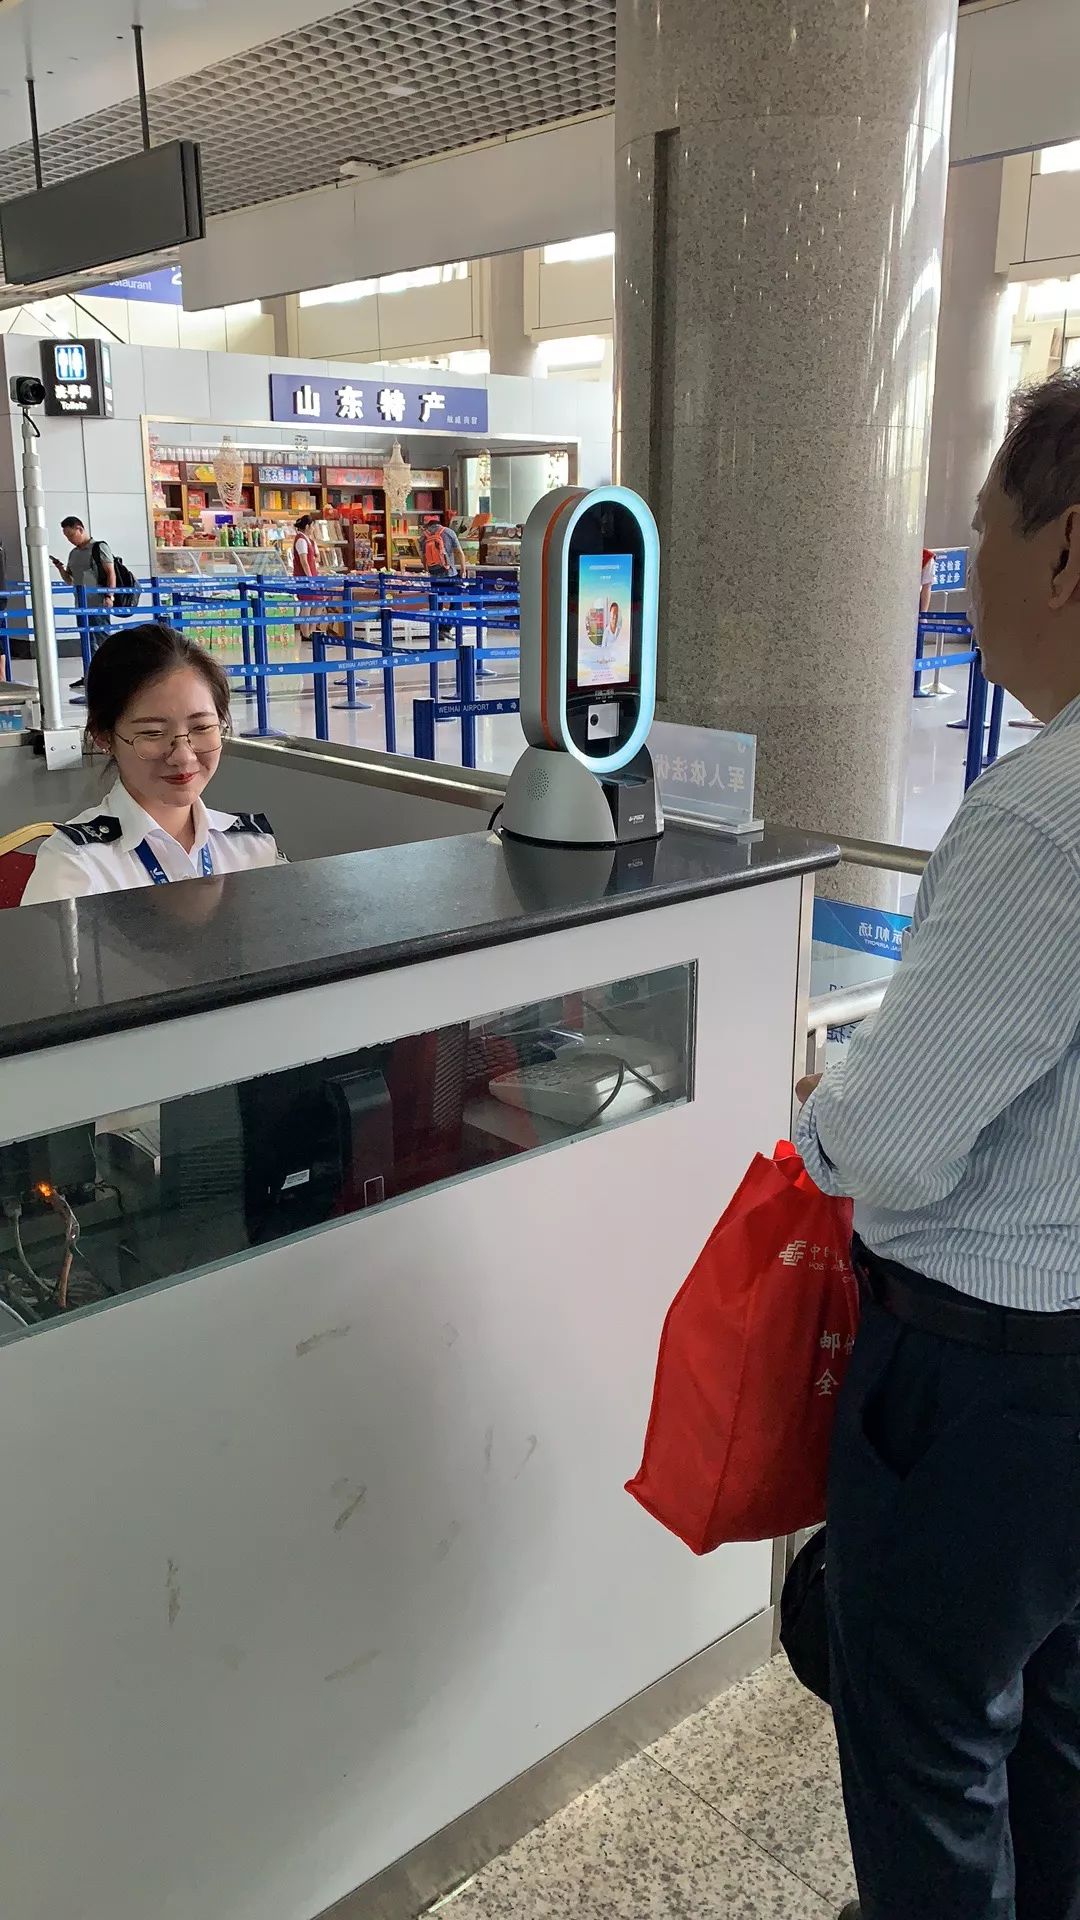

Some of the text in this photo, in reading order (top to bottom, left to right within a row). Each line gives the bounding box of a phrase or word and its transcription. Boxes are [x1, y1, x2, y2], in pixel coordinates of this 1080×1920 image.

[60, 401, 88, 410] Toilets
[296, 384, 446, 422] 山东特产
[438, 705, 461, 714] WEIHAI
[463, 703, 489, 712] AIRPORT
